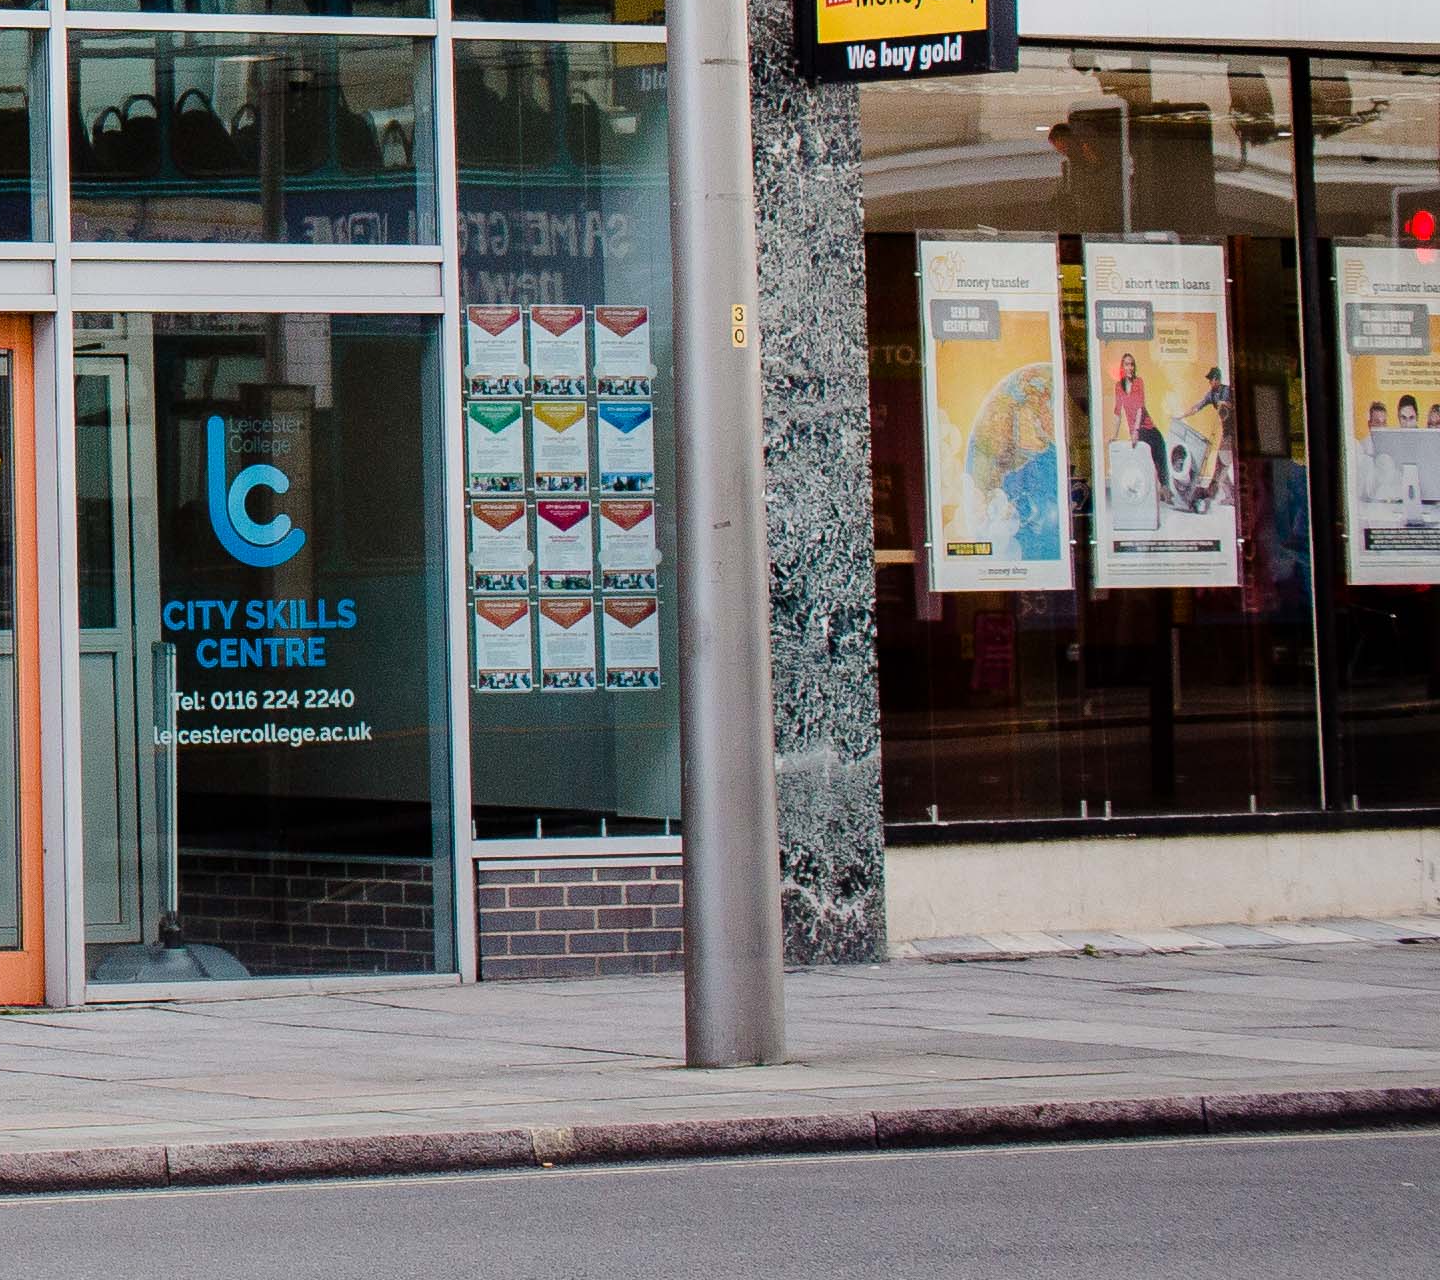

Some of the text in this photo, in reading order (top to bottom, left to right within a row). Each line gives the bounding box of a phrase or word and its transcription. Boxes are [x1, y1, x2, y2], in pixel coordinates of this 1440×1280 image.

[846, 34, 963, 72] We buy gold
[956, 276, 1030, 290] money transfer
[1125, 278, 1211, 290] short term loans
[230, 416, 302, 433] Leicester
[230, 435, 291, 456] College
[163, 599, 357, 630] CITY SKILLS
[196, 637, 326, 668] CENTRE
[171, 689, 355, 711] Tel: 0116 224 2240
[154, 721, 372, 748] leicestercollege.ac.uk
